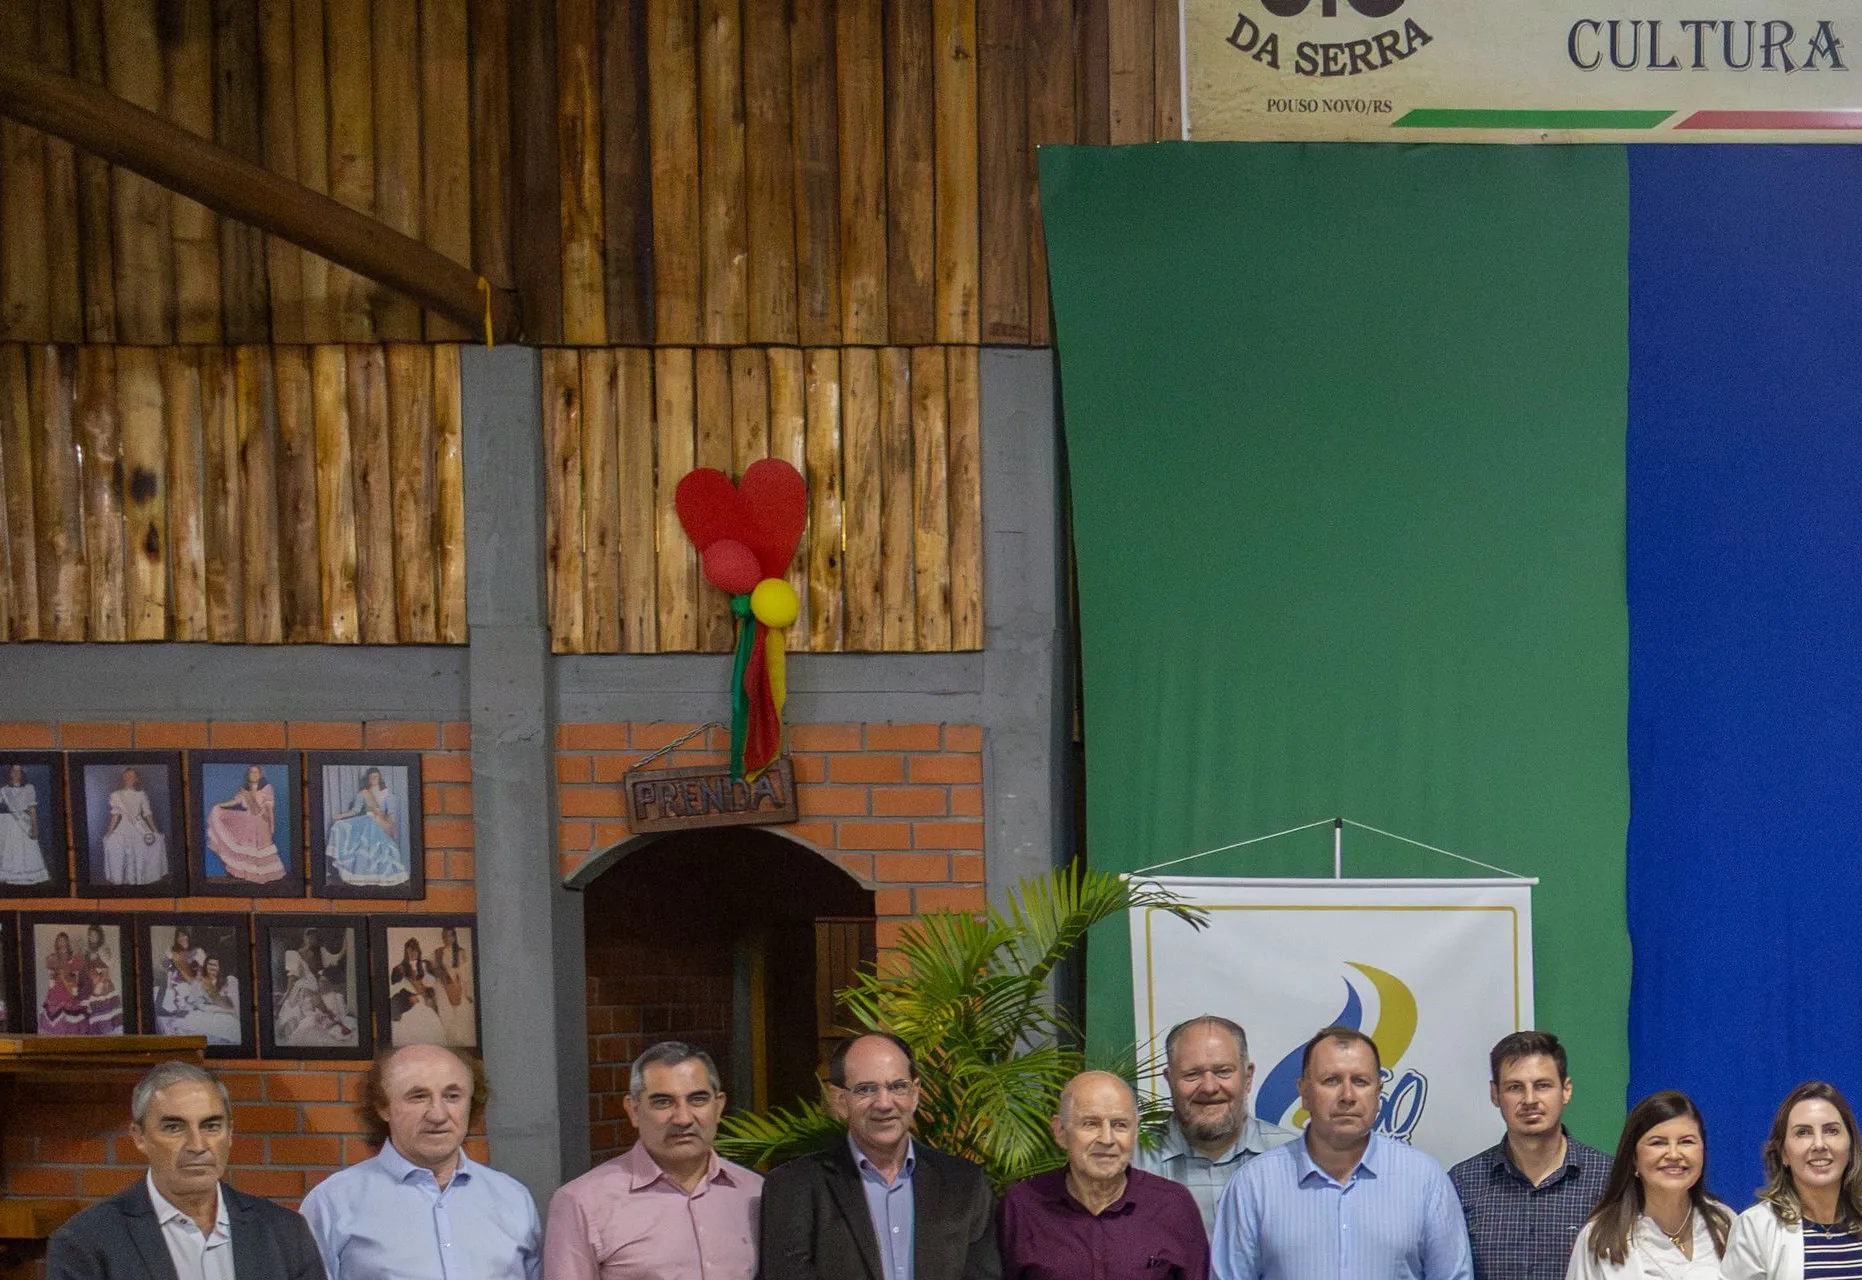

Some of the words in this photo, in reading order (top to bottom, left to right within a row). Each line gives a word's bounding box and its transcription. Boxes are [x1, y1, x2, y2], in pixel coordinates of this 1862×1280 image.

[1225, 13, 1281, 70] DA
[1295, 17, 1433, 77] SERRA
[1568, 19, 1848, 74] CULTURA
[1267, 98, 1318, 113] POUSO
[1322, 98, 1393, 115] NOVO/RS
[633, 776, 785, 820] PRENDA
